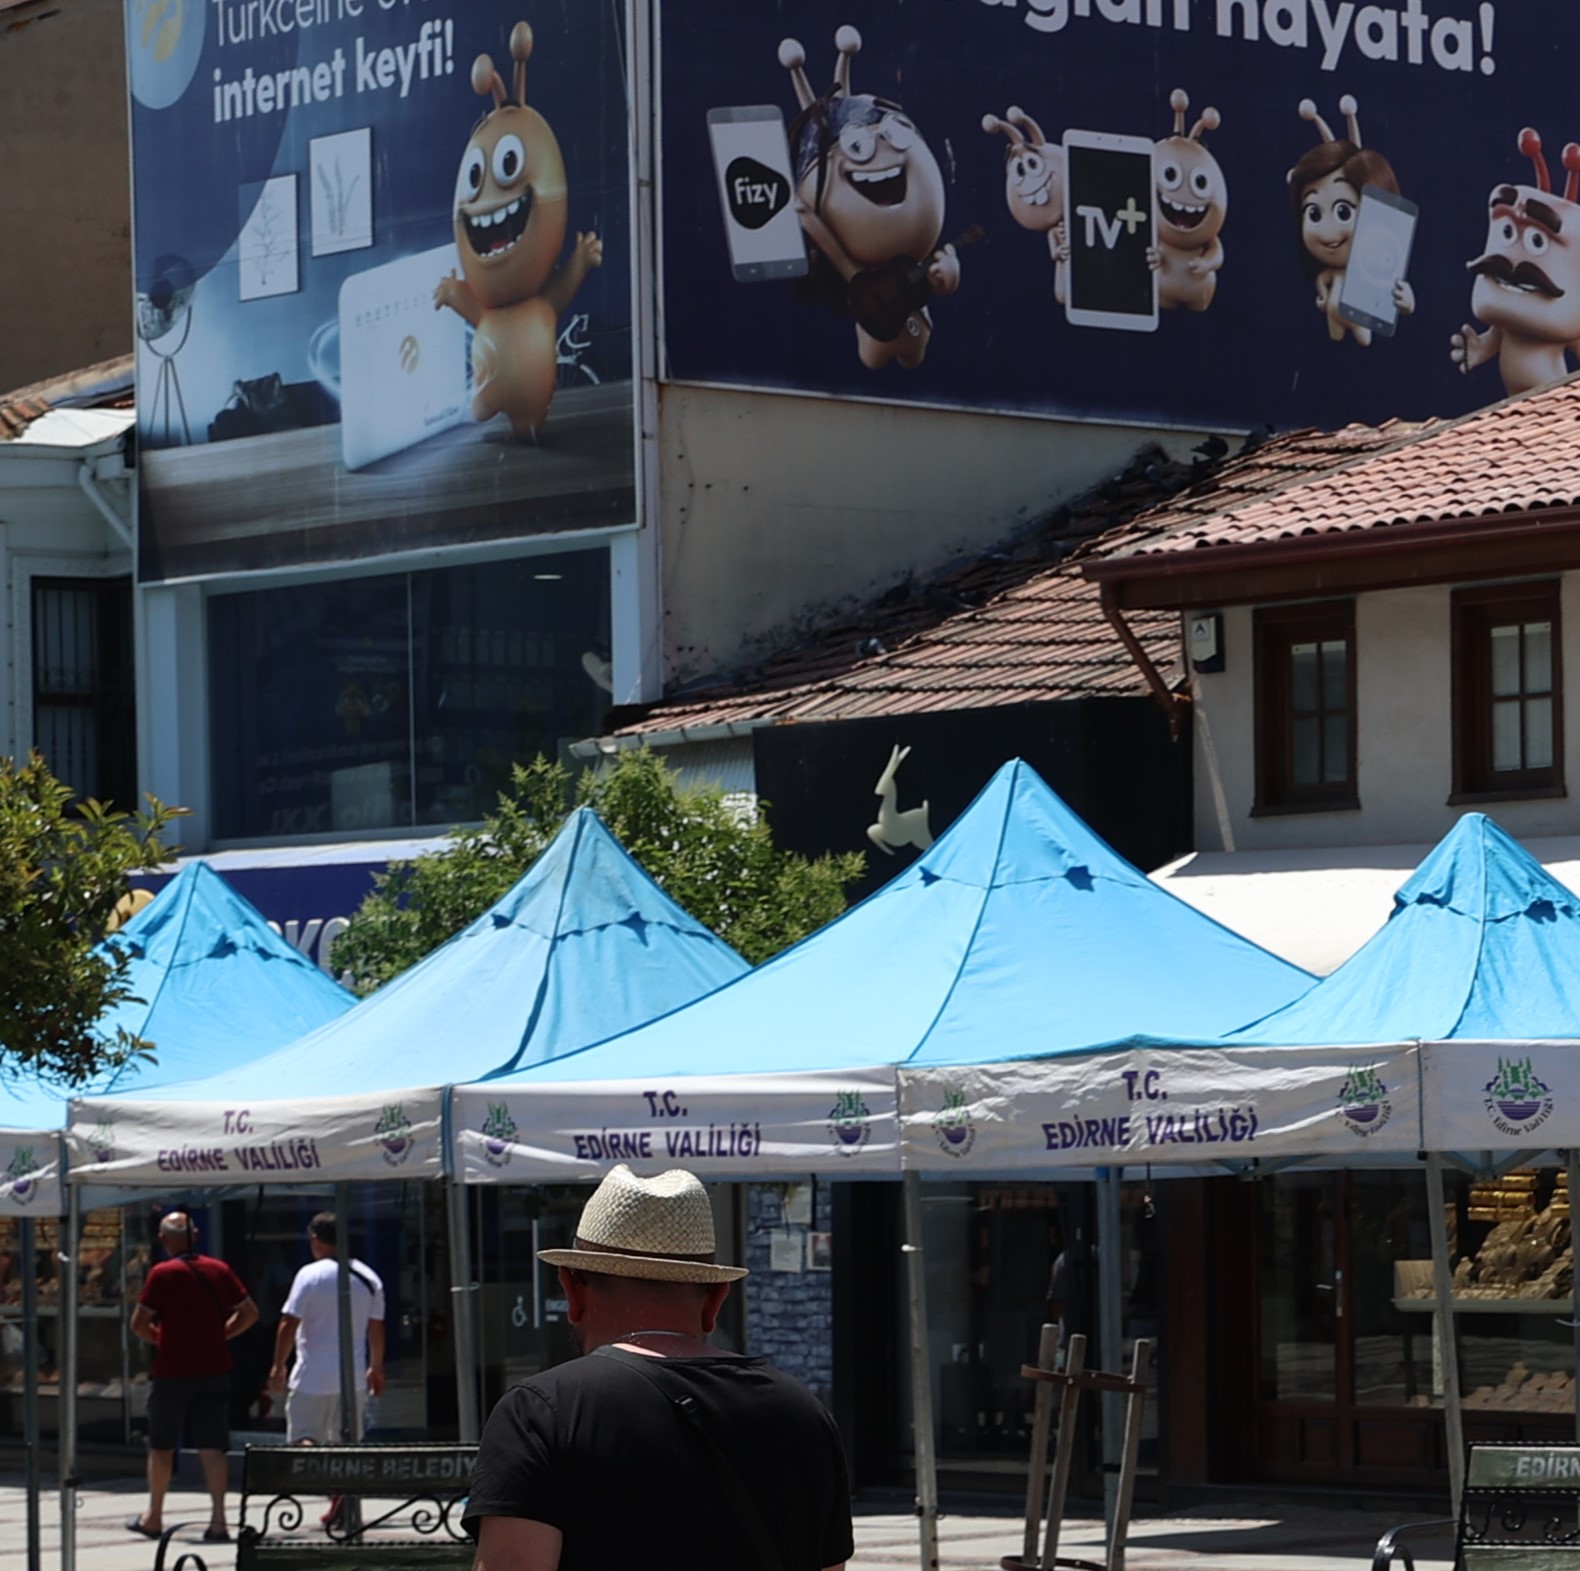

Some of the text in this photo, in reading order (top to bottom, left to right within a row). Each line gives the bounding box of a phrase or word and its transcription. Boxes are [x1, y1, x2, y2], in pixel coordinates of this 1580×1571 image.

[213, 19, 455, 123] internet keyfi!
[733, 176, 778, 210] fizy
[1076, 197, 1147, 250] TV+
[1121, 1069, 1168, 1101] T.C.
[642, 1090, 688, 1118] T.C.
[223, 1109, 253, 1134] T.C.
[1041, 1106, 1259, 1150] EDİRNE VALİLİĞİ
[157, 1138, 321, 1172] EDİRNE VALİLİĞİ
[573, 1122, 762, 1160] EDİRNE VALİLİĞİ
